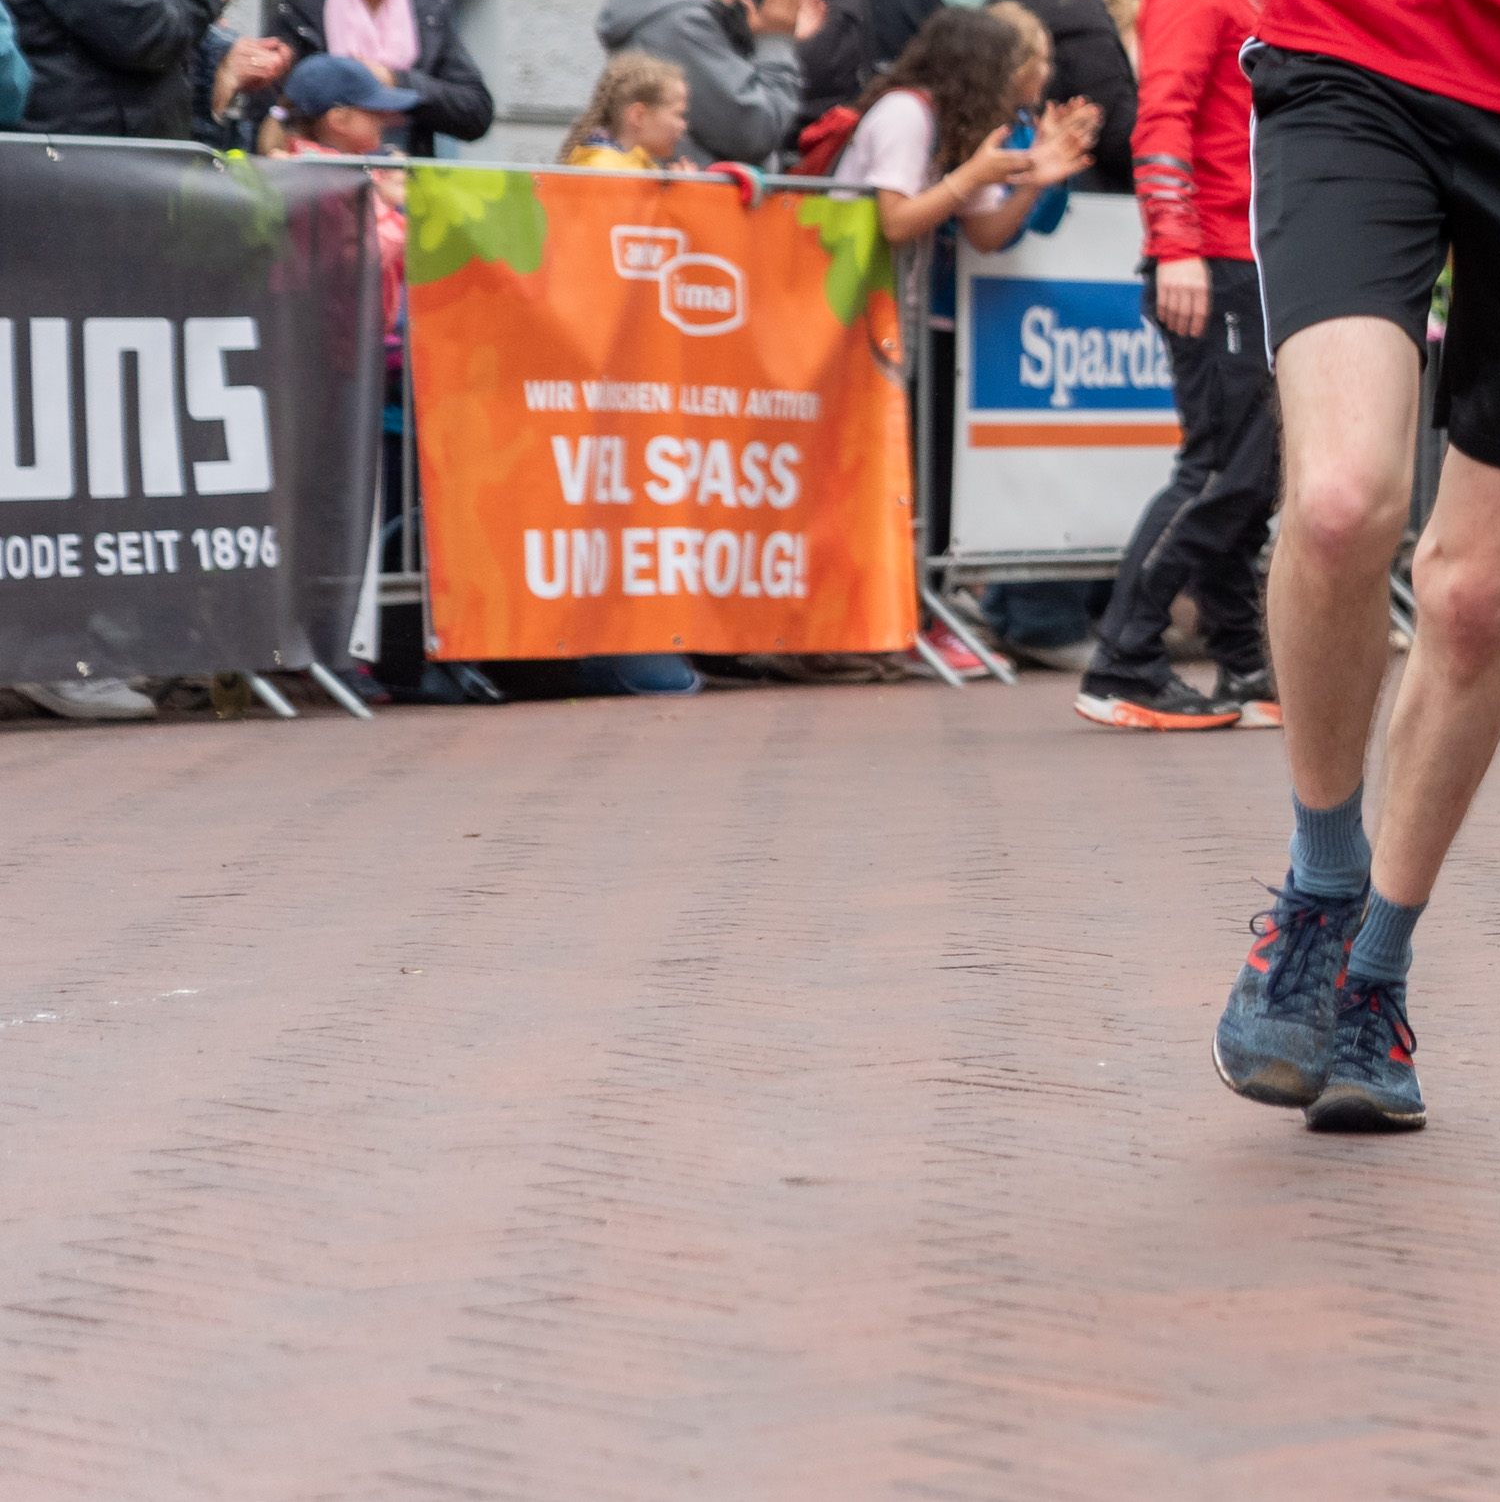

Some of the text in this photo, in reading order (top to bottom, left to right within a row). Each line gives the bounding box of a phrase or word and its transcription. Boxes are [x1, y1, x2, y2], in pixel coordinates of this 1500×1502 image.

[523, 379, 576, 412] WIR
[0, 524, 282, 581] ODE SEIT 1896
